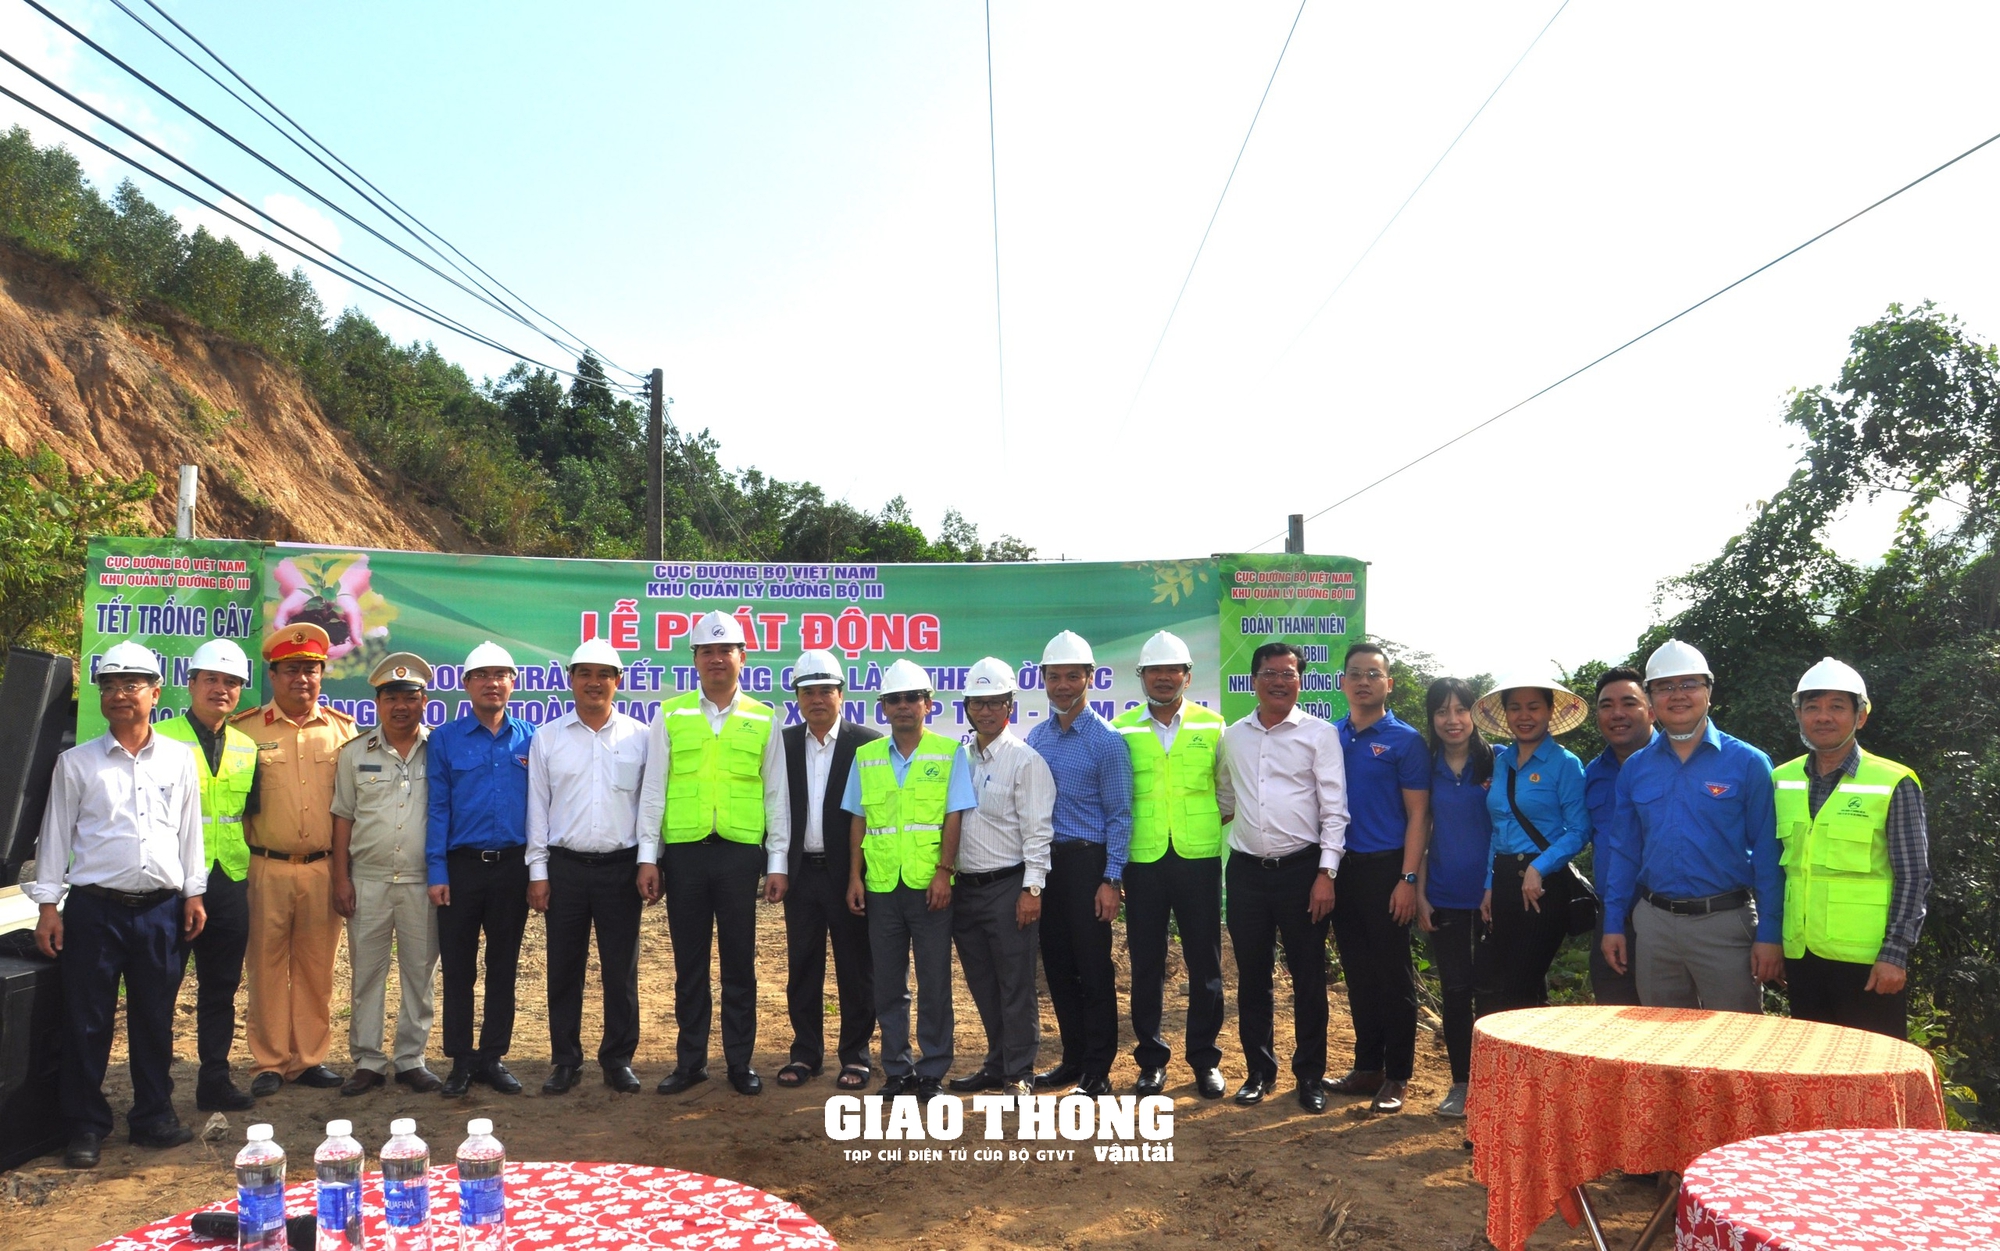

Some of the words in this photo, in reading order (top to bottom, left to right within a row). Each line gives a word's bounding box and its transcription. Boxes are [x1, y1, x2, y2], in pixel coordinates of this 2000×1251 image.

[106, 556, 130, 570] CỤC
[133, 555, 171, 569] ĐƯỜNG
[174, 556, 190, 572] BỘ
[193, 557, 217, 573] VIỆT
[218, 561, 246, 572] NAM
[655, 565, 691, 581] CỤC
[696, 564, 758, 579] ĐƯỜNG
[763, 565, 788, 582] BỘ
[792, 565, 831, 582] VIỆT
[834, 566, 877, 580] NAM
[100, 573, 124, 585] KHU
[127, 571, 159, 587] QUẢN
[161, 574, 174, 587] LÝ
[178, 574, 216, 589] ĐƯỜNG
[219, 577, 234, 592] BỘ
[237, 579, 250, 590] III
[1235, 571, 1256, 584] CỤC
[1258, 570, 1291, 583] ĐƯỜNG
[1293, 570, 1307, 585] BỘ
[1309, 570, 1330, 585] VIỆT
[1331, 572, 1353, 584] NAM
[647, 583, 684, 598] KHU
[689, 580, 739, 598] QUẢN
[743, 581, 764, 598] LÝ
[769, 581, 831, 598] ĐƯỜNG
[836, 582, 861, 602] BỘ
[865, 584, 883, 598] III
[1231, 588, 1251, 599] KHU
[1253, 585, 1280, 600] QUẢN
[1282, 588, 1294, 599] LÝ
[1297, 587, 1329, 599] ĐƯỜNG
[1331, 587, 1344, 602] BỘ
[1345, 588, 1355, 599] III
[96, 594, 132, 633] TẾT
[138, 595, 206, 636] TRỒNG
[213, 602, 253, 637] CÂY
[1241, 613, 1274, 635] ĐOÀN
[1277, 616, 1315, 634] THANH
[1318, 613, 1346, 635] NIÊN
[656, 606, 788, 651] PÁT
[799, 606, 940, 660] ĐỘNG
[512, 660, 573, 691] TRÀ
